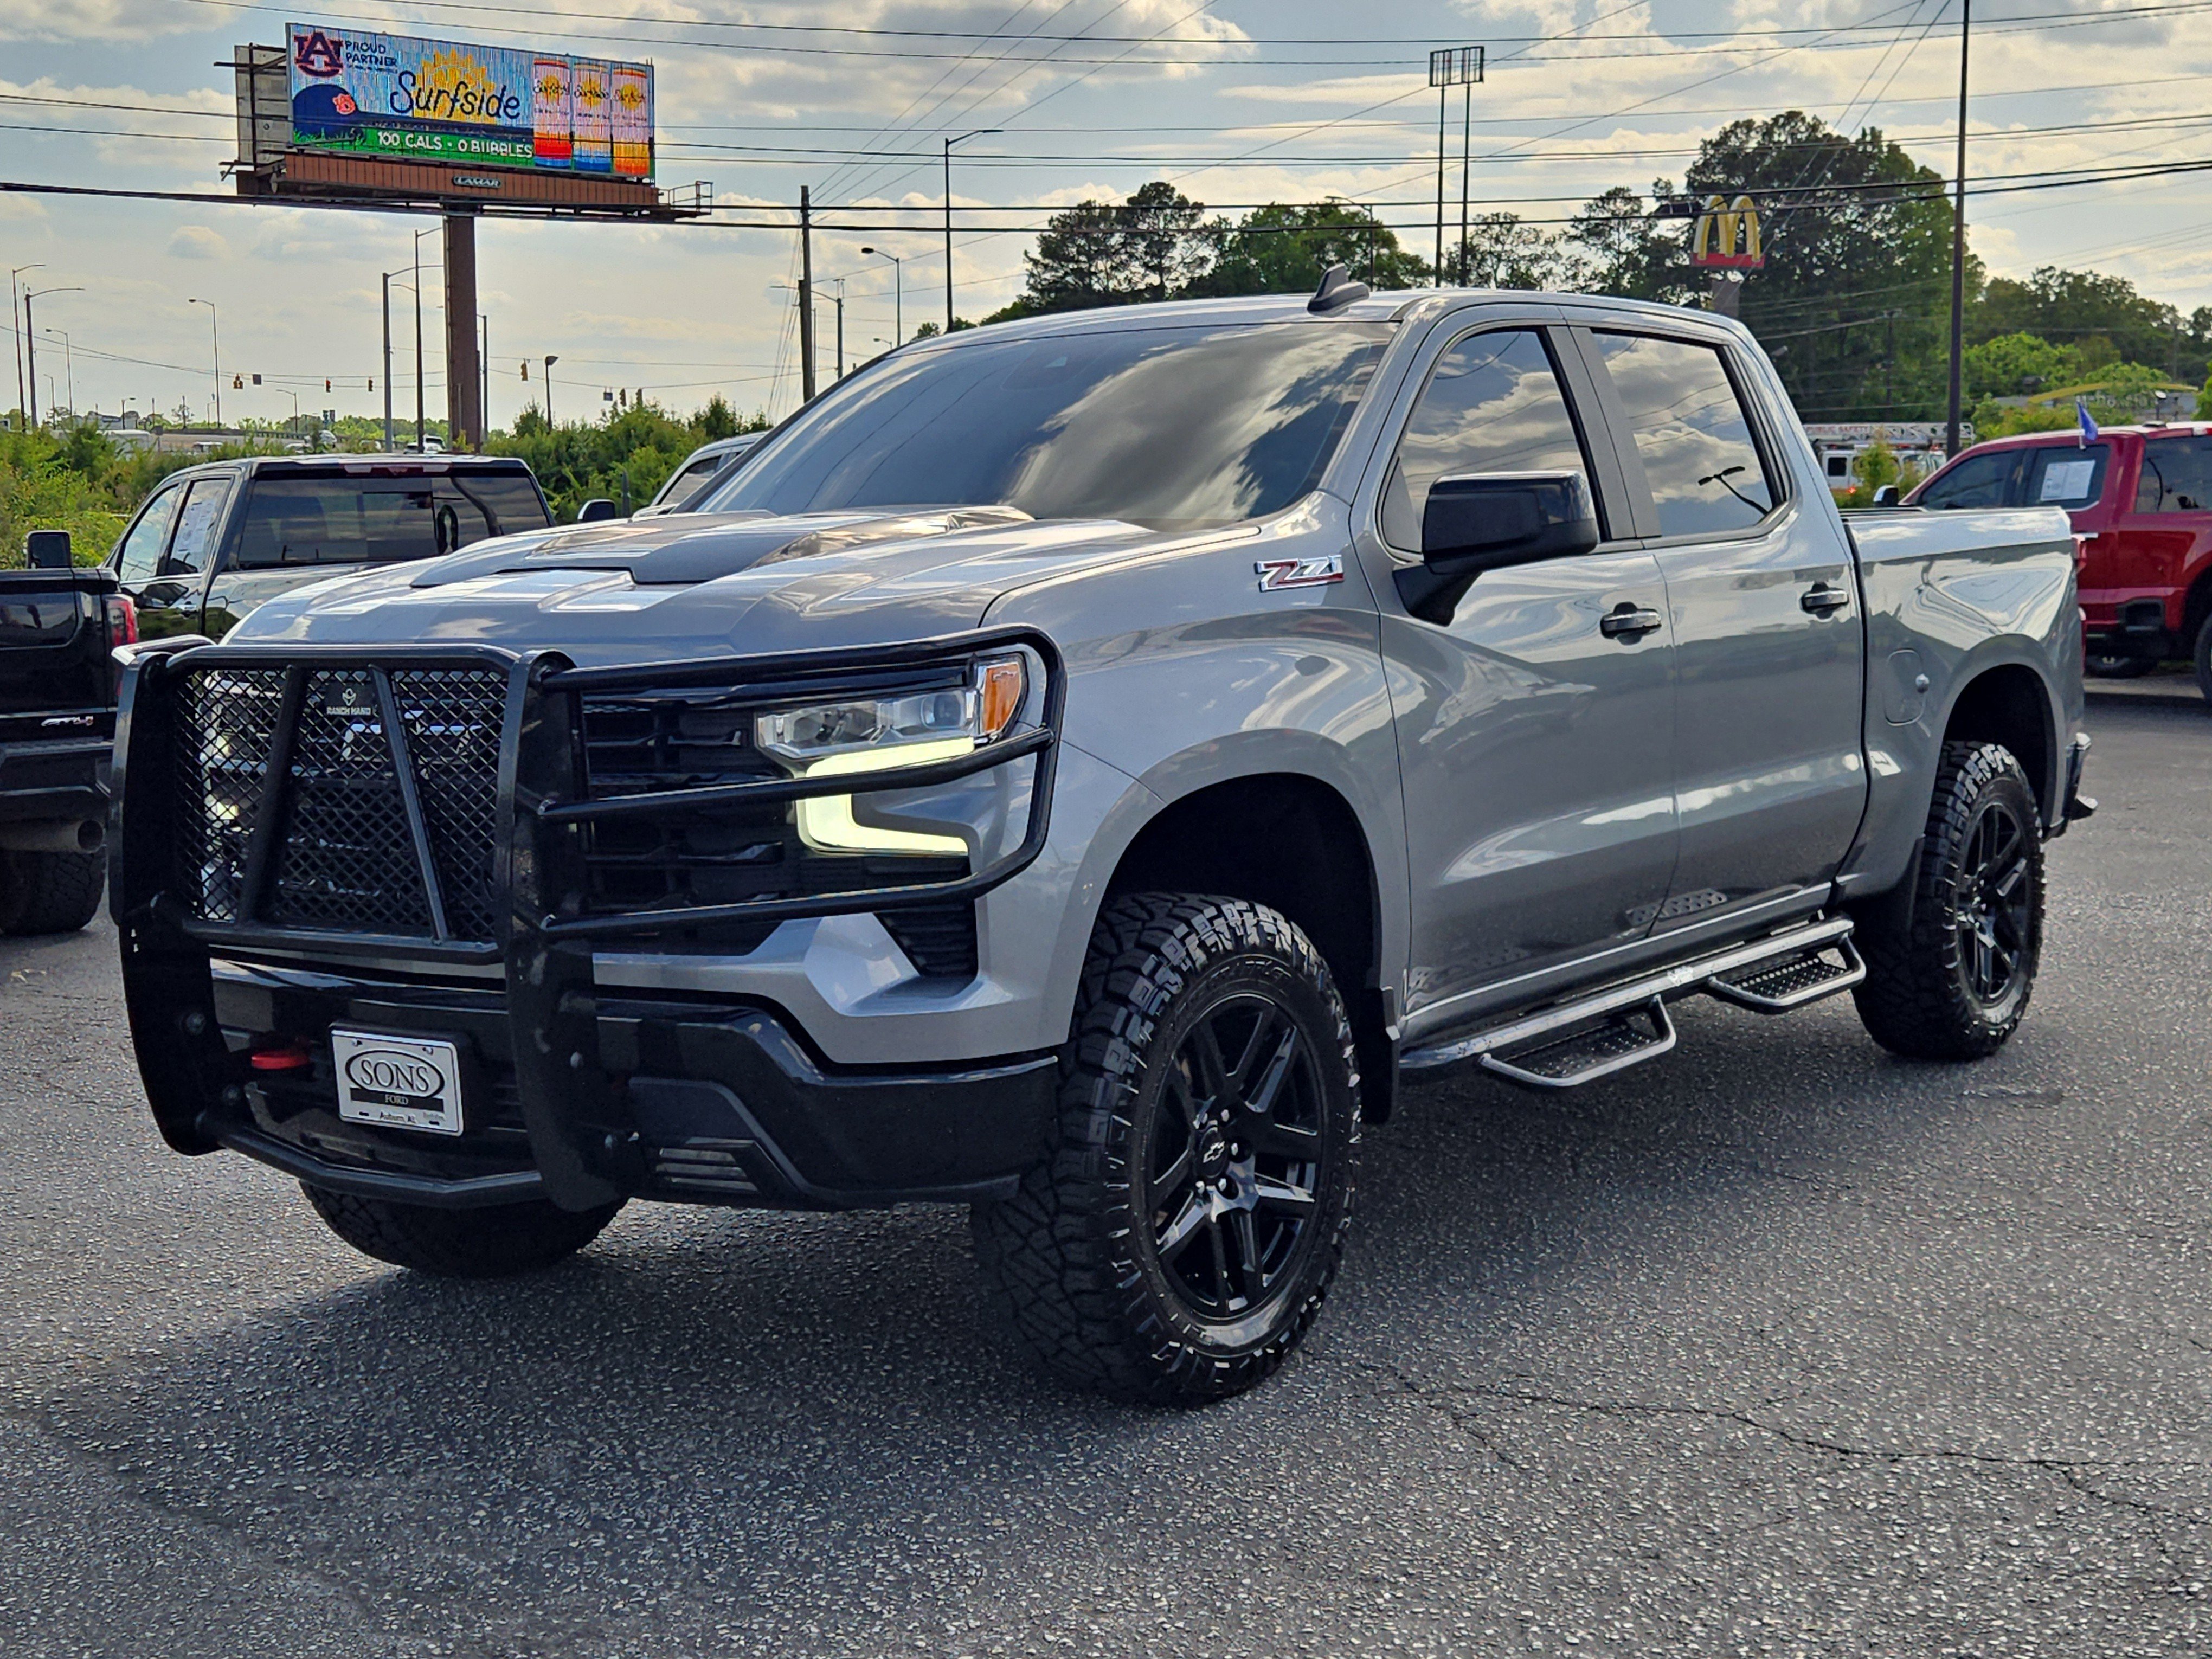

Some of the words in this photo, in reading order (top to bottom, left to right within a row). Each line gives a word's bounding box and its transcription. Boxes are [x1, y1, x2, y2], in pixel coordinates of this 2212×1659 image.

[345, 40, 386, 54] PROUD
[345, 52, 397, 67] PARTNER
[390, 70, 520, 119] Surfside
[378, 132, 400, 146] 100
[405, 134, 442, 150] CALS
[471, 140, 532, 158] BUBBLES
[1254, 554, 1345, 593] Z71
[361, 1059, 429, 1092] SONS
[384, 1094, 409, 1105] FORD
